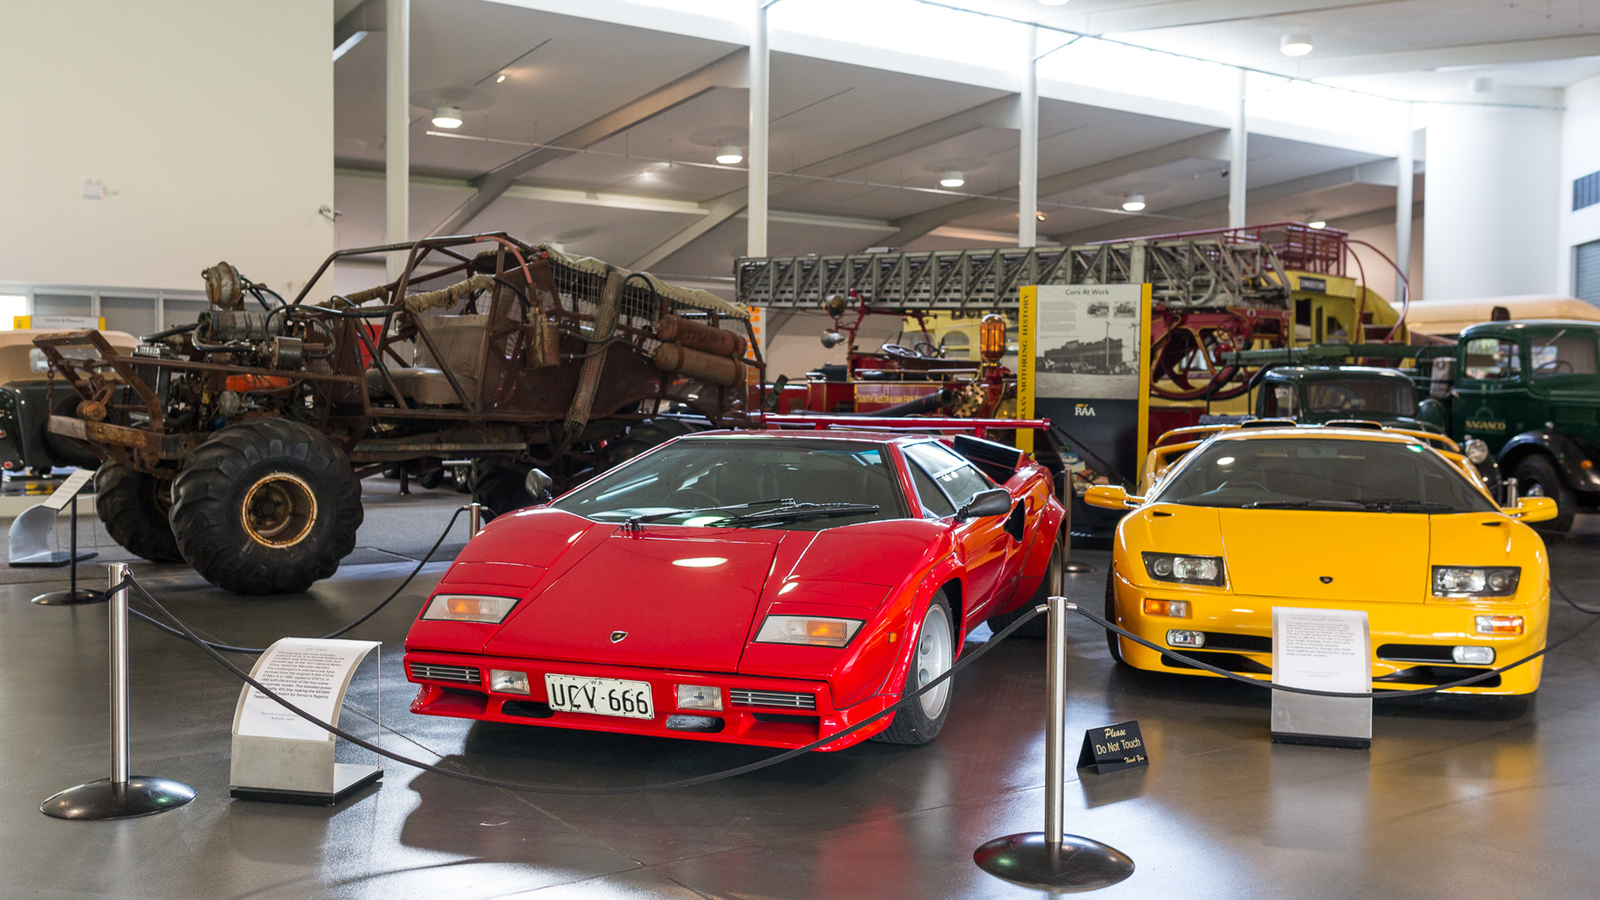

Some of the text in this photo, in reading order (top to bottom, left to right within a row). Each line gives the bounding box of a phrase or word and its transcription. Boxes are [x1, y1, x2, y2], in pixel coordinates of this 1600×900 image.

[1074, 406, 1096, 417] RAA
[1104, 728, 1126, 739] Please
[1096, 737, 1141, 755] Do Not Touch
